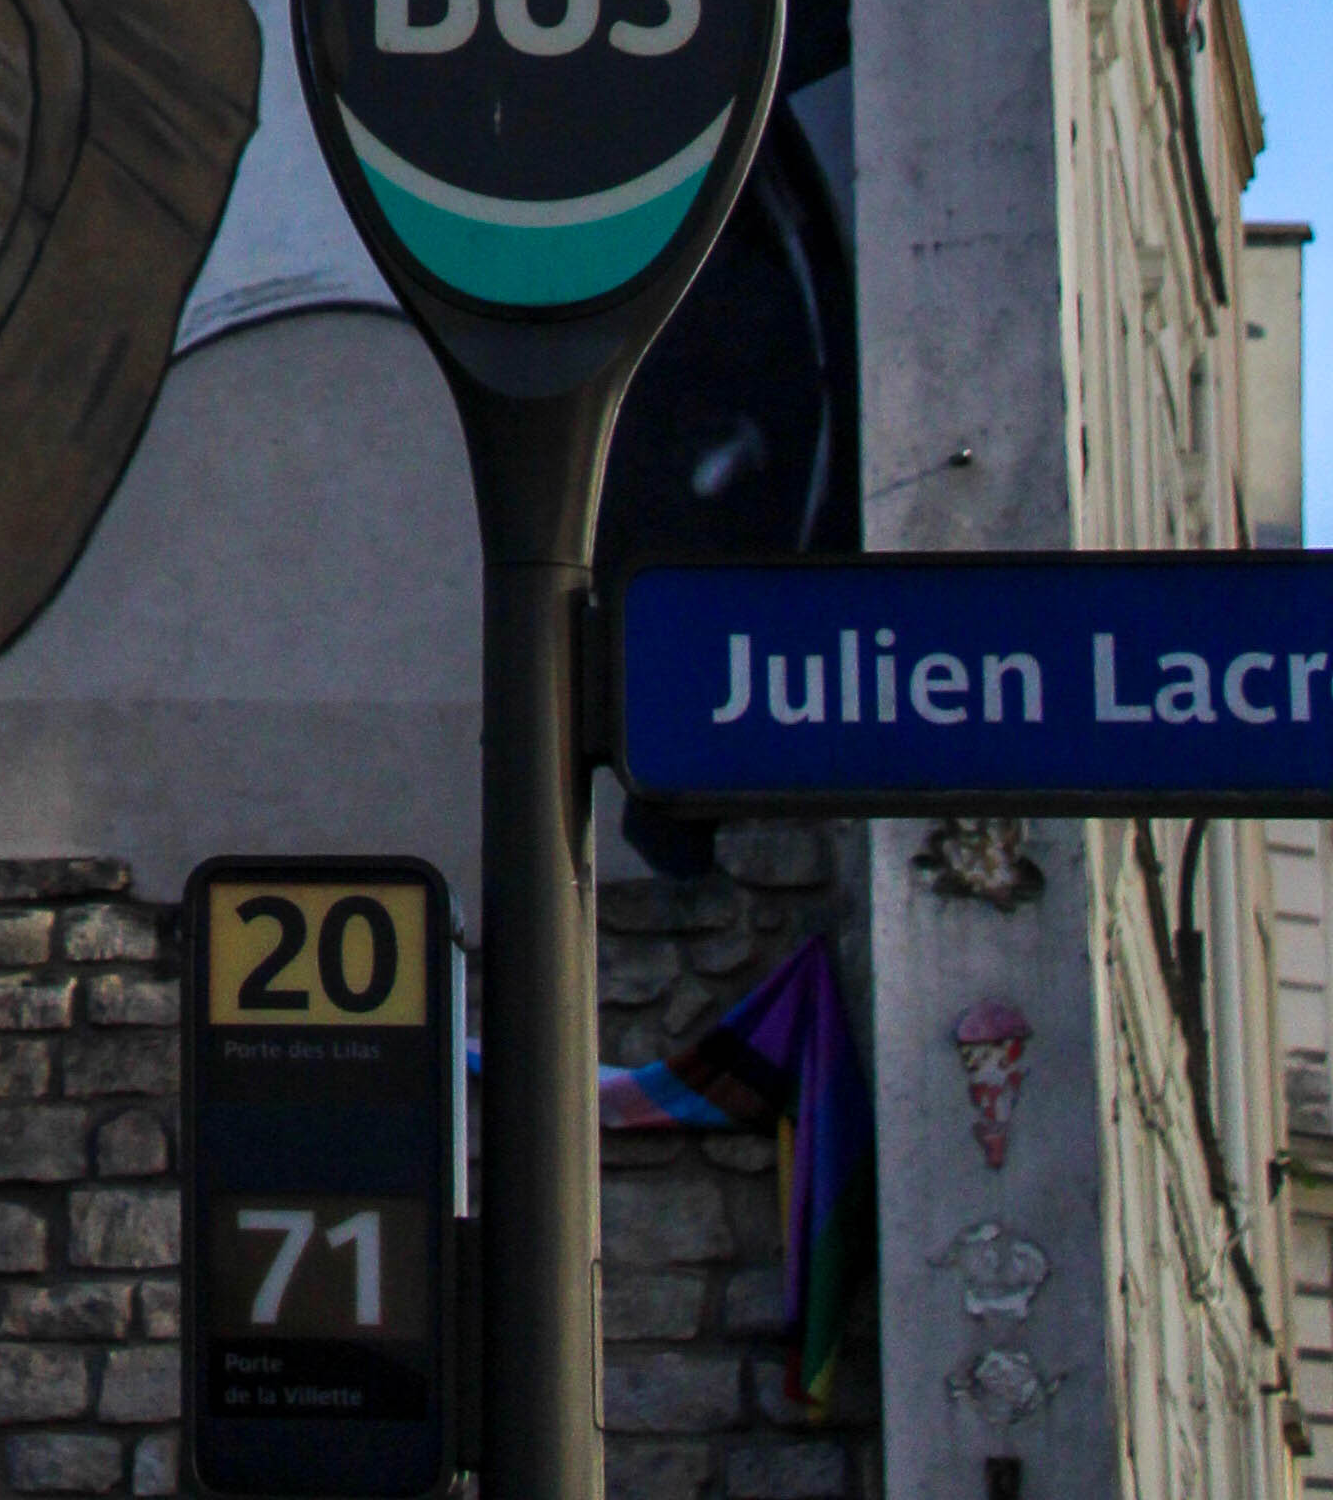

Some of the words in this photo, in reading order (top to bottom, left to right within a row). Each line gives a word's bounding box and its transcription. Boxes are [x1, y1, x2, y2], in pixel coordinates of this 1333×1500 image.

[711, 628, 1044, 726] Julien
[1092, 632, 1333, 726] Lacr
[235, 895, 399, 1014] 20
[224, 1039, 283, 1060] Porte
[288, 1039, 325, 1060] des
[333, 1039, 382, 1060] Lilas
[237, 1209, 382, 1328] 71
[223, 1350, 285, 1374] Porte
[222, 1384, 253, 1405] de
[258, 1384, 278, 1405] la
[283, 1384, 364, 1405] Villette
